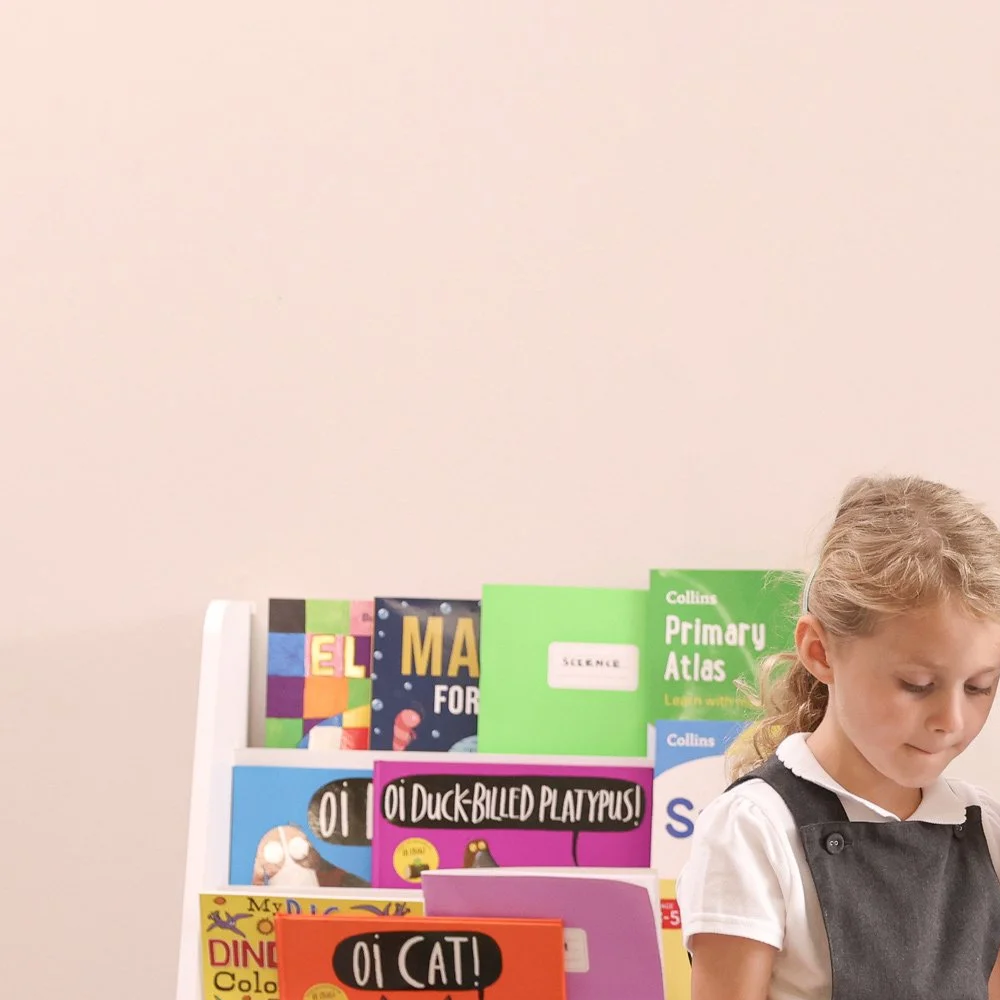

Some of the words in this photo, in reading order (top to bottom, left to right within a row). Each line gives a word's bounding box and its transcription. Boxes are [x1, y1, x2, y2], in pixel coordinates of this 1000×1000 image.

[665, 590, 718, 605] Collins
[665, 614, 766, 650] Primary
[310, 634, 366, 678] EL
[663, 651, 726, 682] Atlas
[666, 732, 716, 748] Collins
[247, 896, 283, 916] My
[398, 935, 480, 989] CAT!
